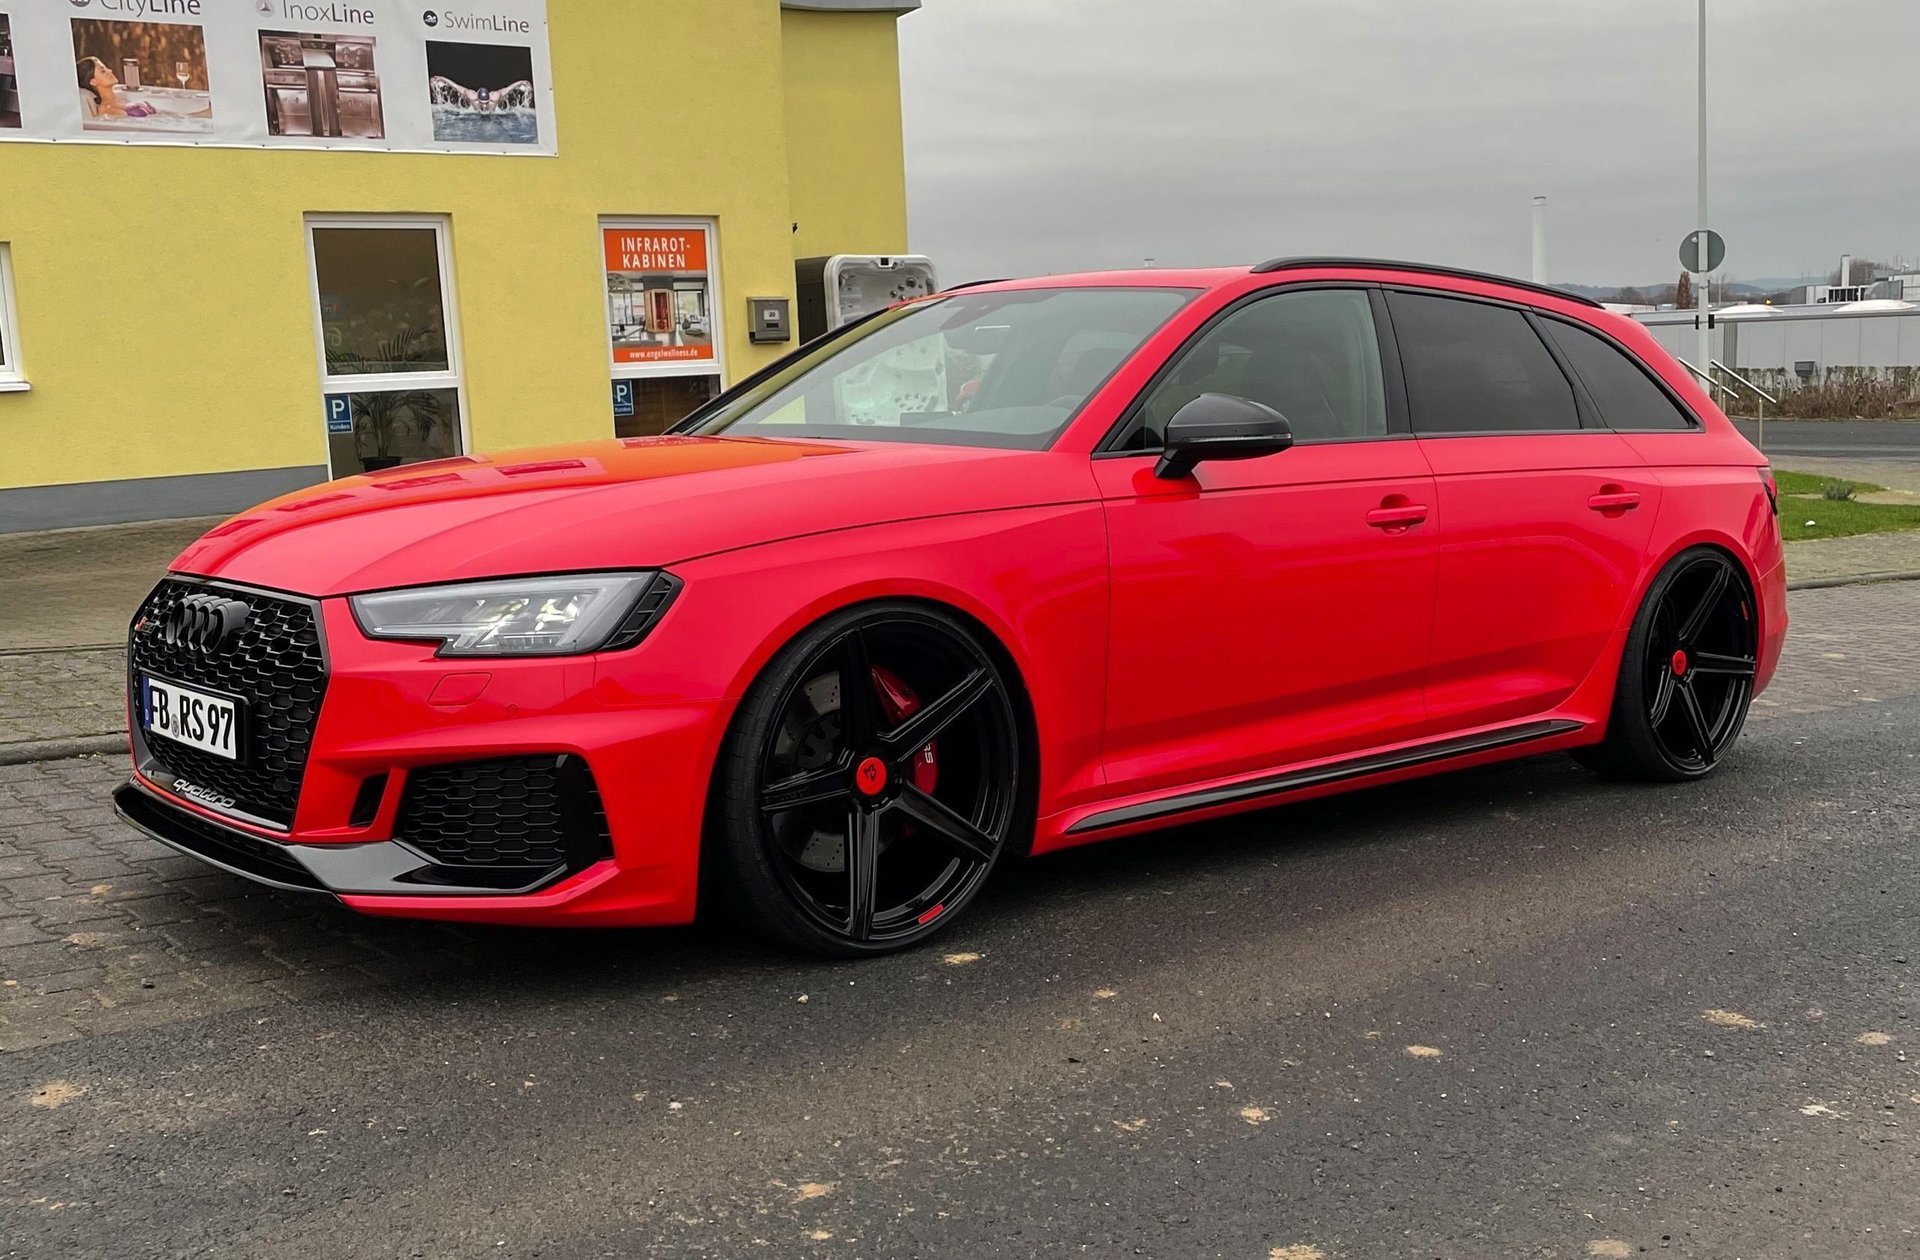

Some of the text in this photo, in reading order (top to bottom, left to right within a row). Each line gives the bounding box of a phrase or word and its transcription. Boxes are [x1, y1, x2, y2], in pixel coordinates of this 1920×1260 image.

[283, 0, 374, 24] InoxLine
[444, 11, 530, 33] SwimLine
[621, 237, 691, 252] INFRAROT-
[622, 253, 686, 269] KABINEN
[616, 384, 628, 403] P
[331, 399, 345, 419] P
[149, 685, 233, 750] FB RS 97
[172, 778, 236, 808] quattro
